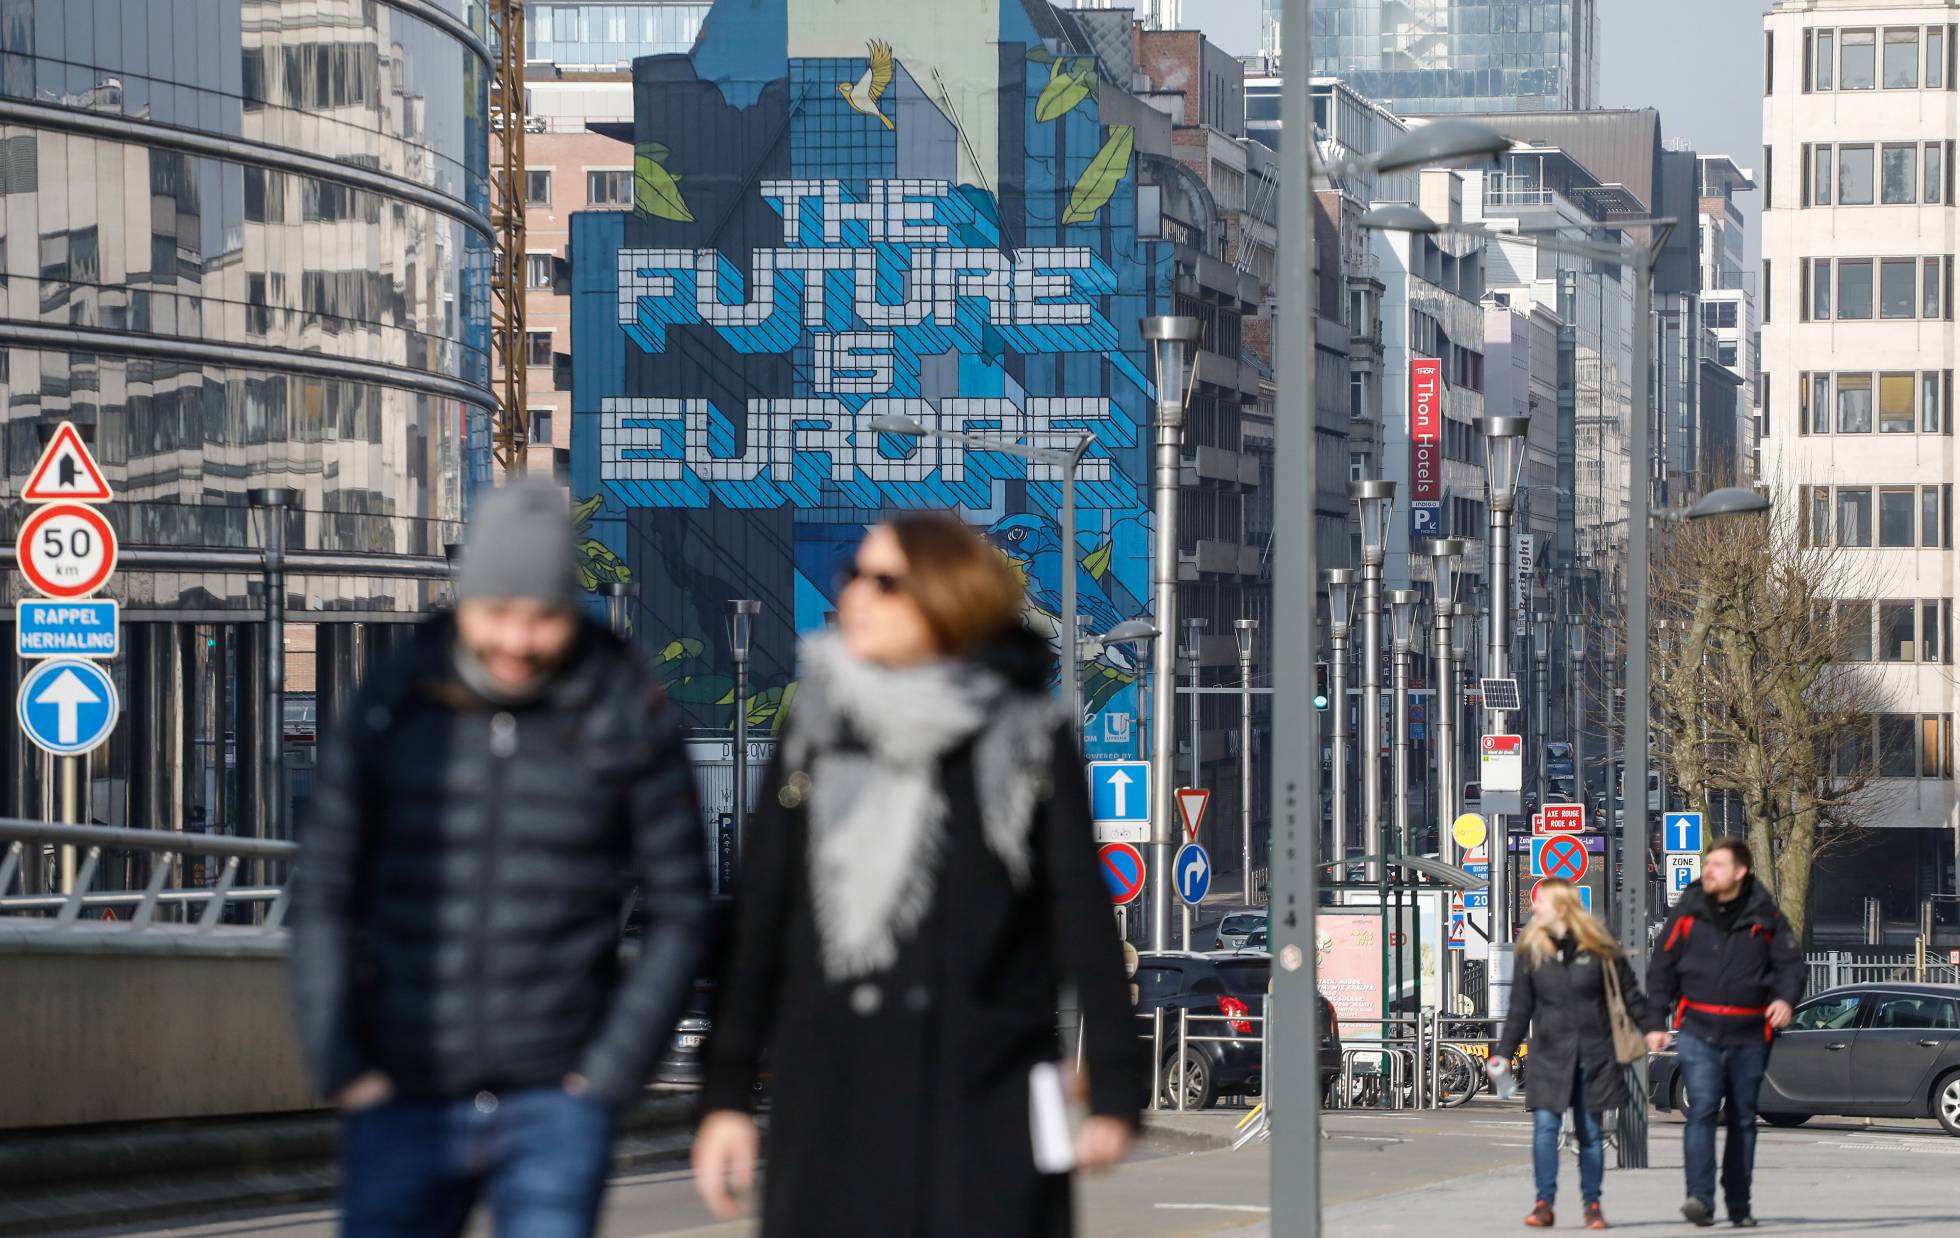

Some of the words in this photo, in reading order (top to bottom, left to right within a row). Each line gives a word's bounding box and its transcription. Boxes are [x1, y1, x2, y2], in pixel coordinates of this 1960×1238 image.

[760, 179, 950, 243] THE
[617, 247, 1092, 326] FUTURE
[813, 330, 895, 394] IS
[1418, 379, 1434, 426] Thon
[600, 396, 1111, 482] EUROPE
[1418, 434, 1434, 492] Hotels
[1414, 509, 1430, 530] P
[43, 528, 92, 558] 50
[55, 563, 79, 577] km
[33, 608, 101, 625] RAPPEL
[20, 631, 115, 649] HERHALING
[722, 817, 731, 828] P
[1547, 810, 1559, 818] AXE
[1561, 810, 1580, 818] ROUGE
[1550, 819, 1566, 827] RODE
[1568, 819, 1577, 827] AS
[1672, 857, 1694, 866] ZONE
[1678, 869, 1688, 882] P
[1473, 895, 1488, 906] 20
